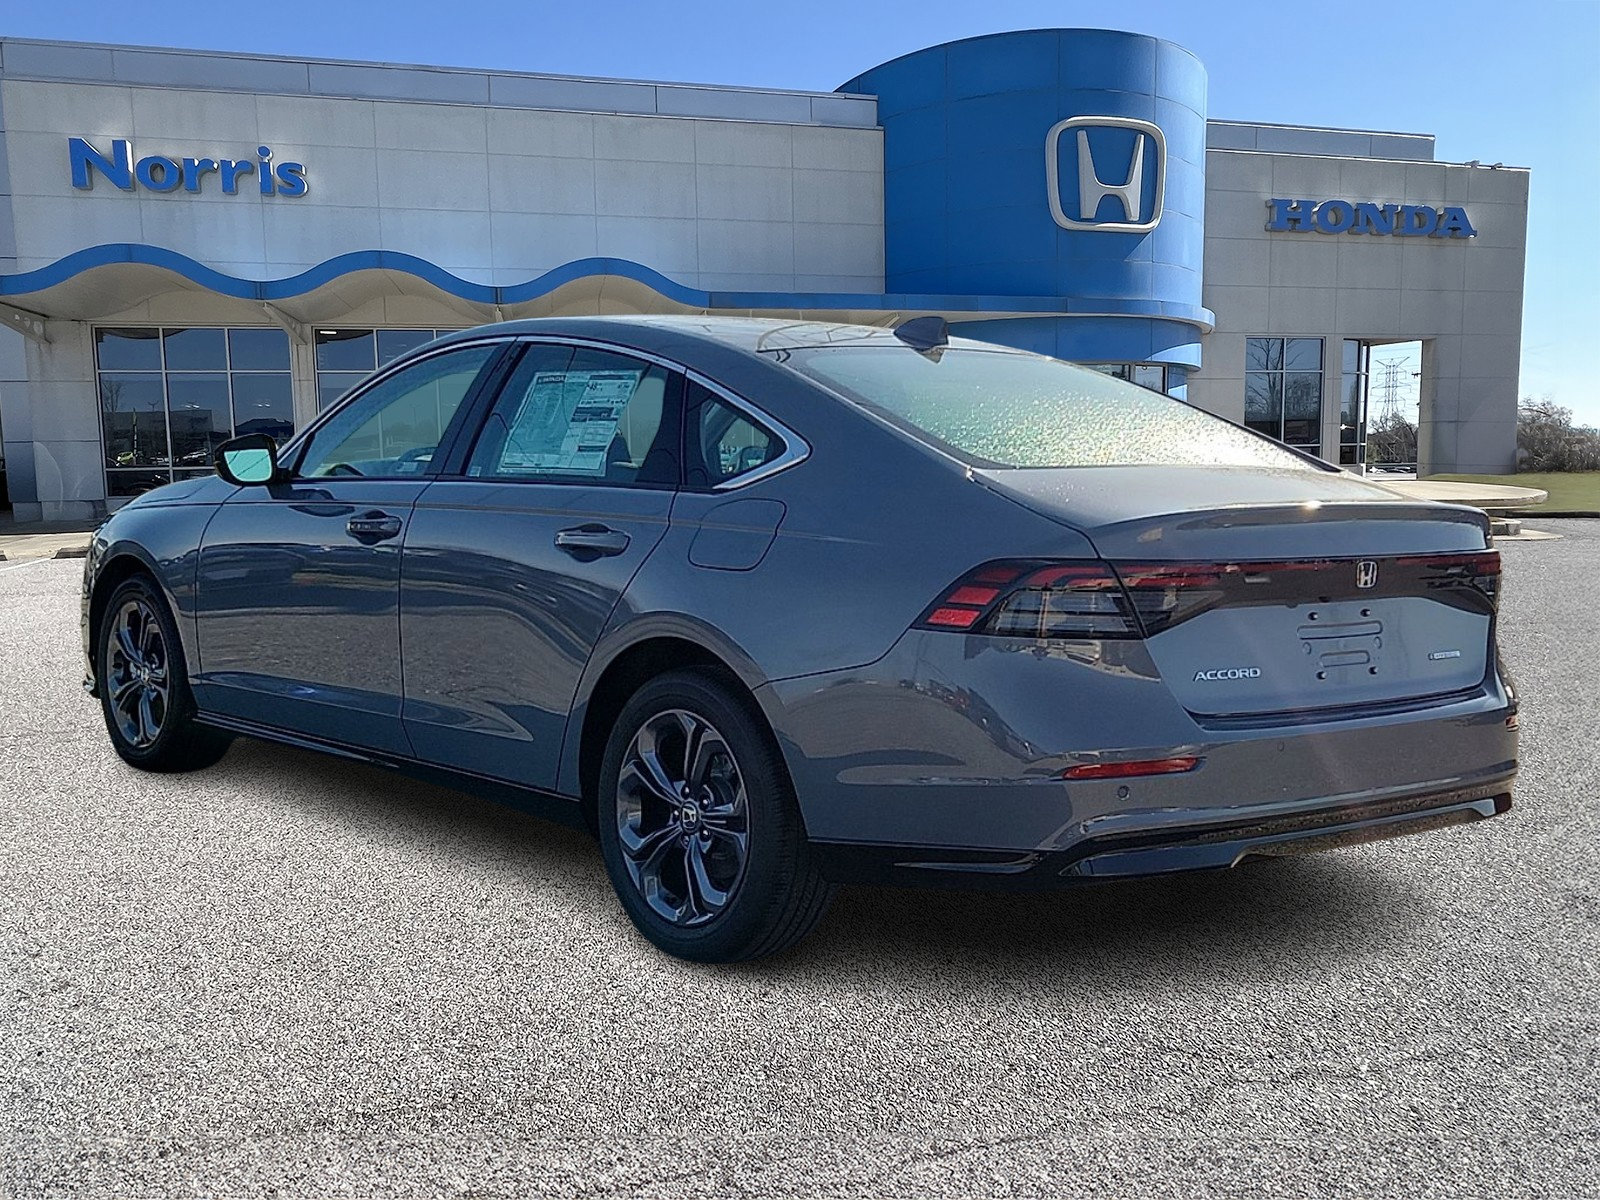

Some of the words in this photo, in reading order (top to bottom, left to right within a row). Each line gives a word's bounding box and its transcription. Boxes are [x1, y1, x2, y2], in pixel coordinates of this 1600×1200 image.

[68, 137, 309, 197] Norris
[1265, 198, 1478, 239] HONDA
[1194, 667, 1261, 682] ACCORD
